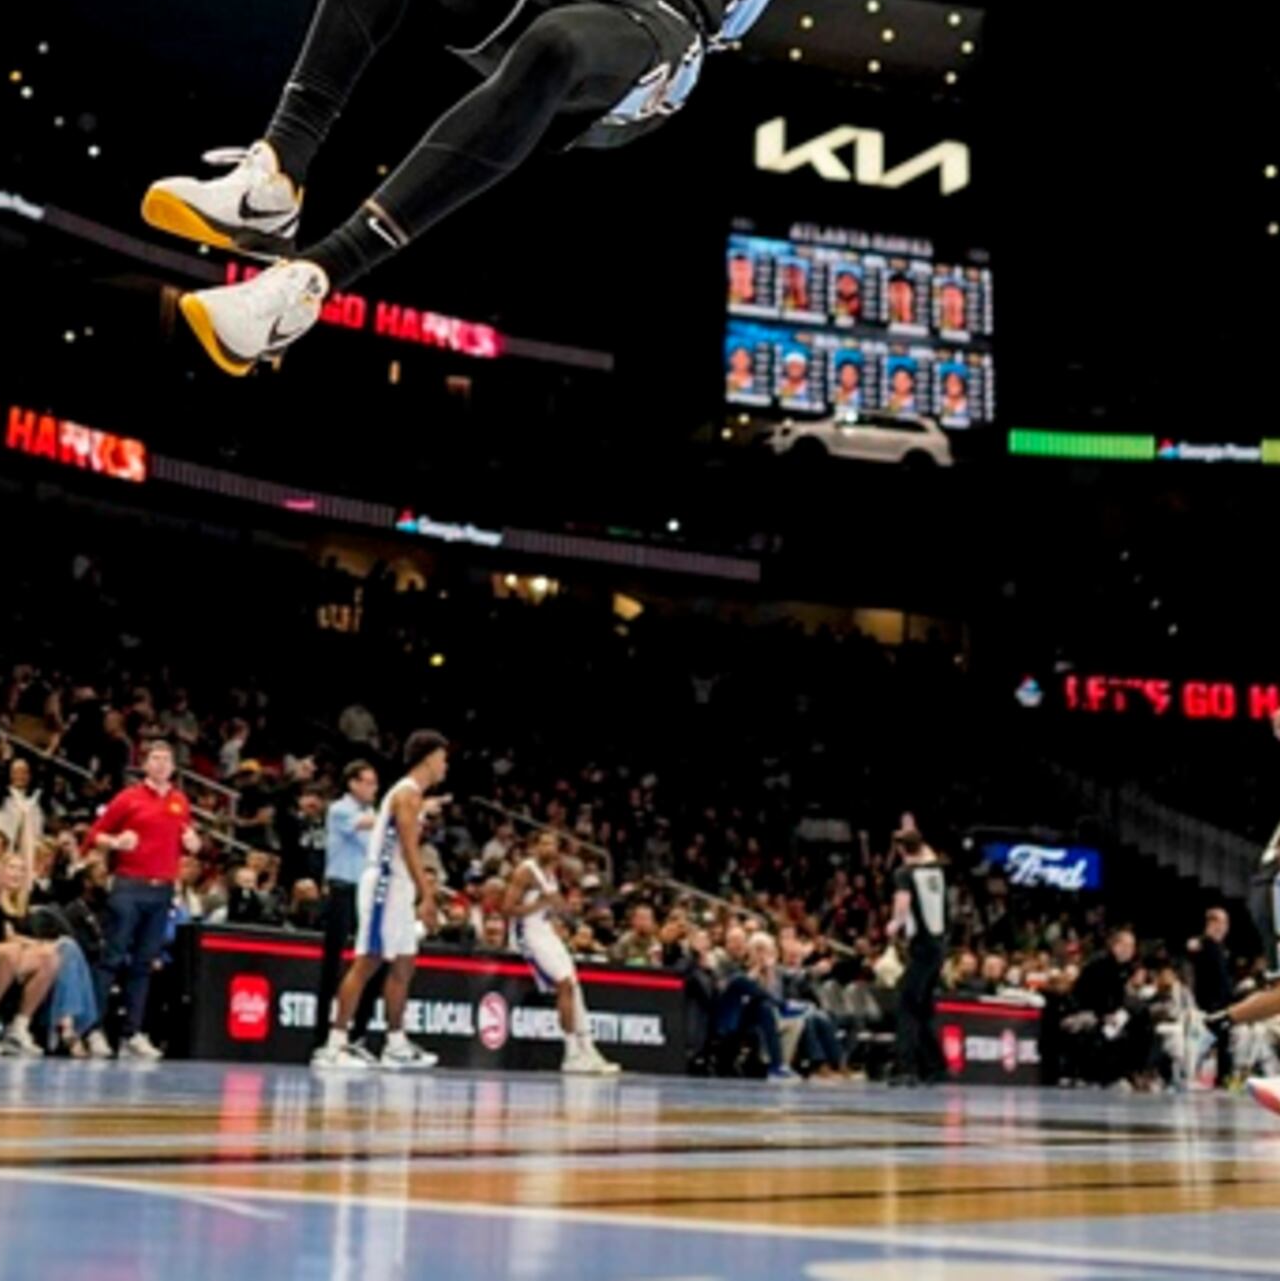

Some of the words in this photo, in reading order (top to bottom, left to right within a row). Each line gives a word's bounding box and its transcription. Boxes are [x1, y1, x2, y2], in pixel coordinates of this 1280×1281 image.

[6, 406, 148, 484] HAWKS
[1183, 682, 1236, 719] GO
[1004, 843, 1087, 891] Ford
